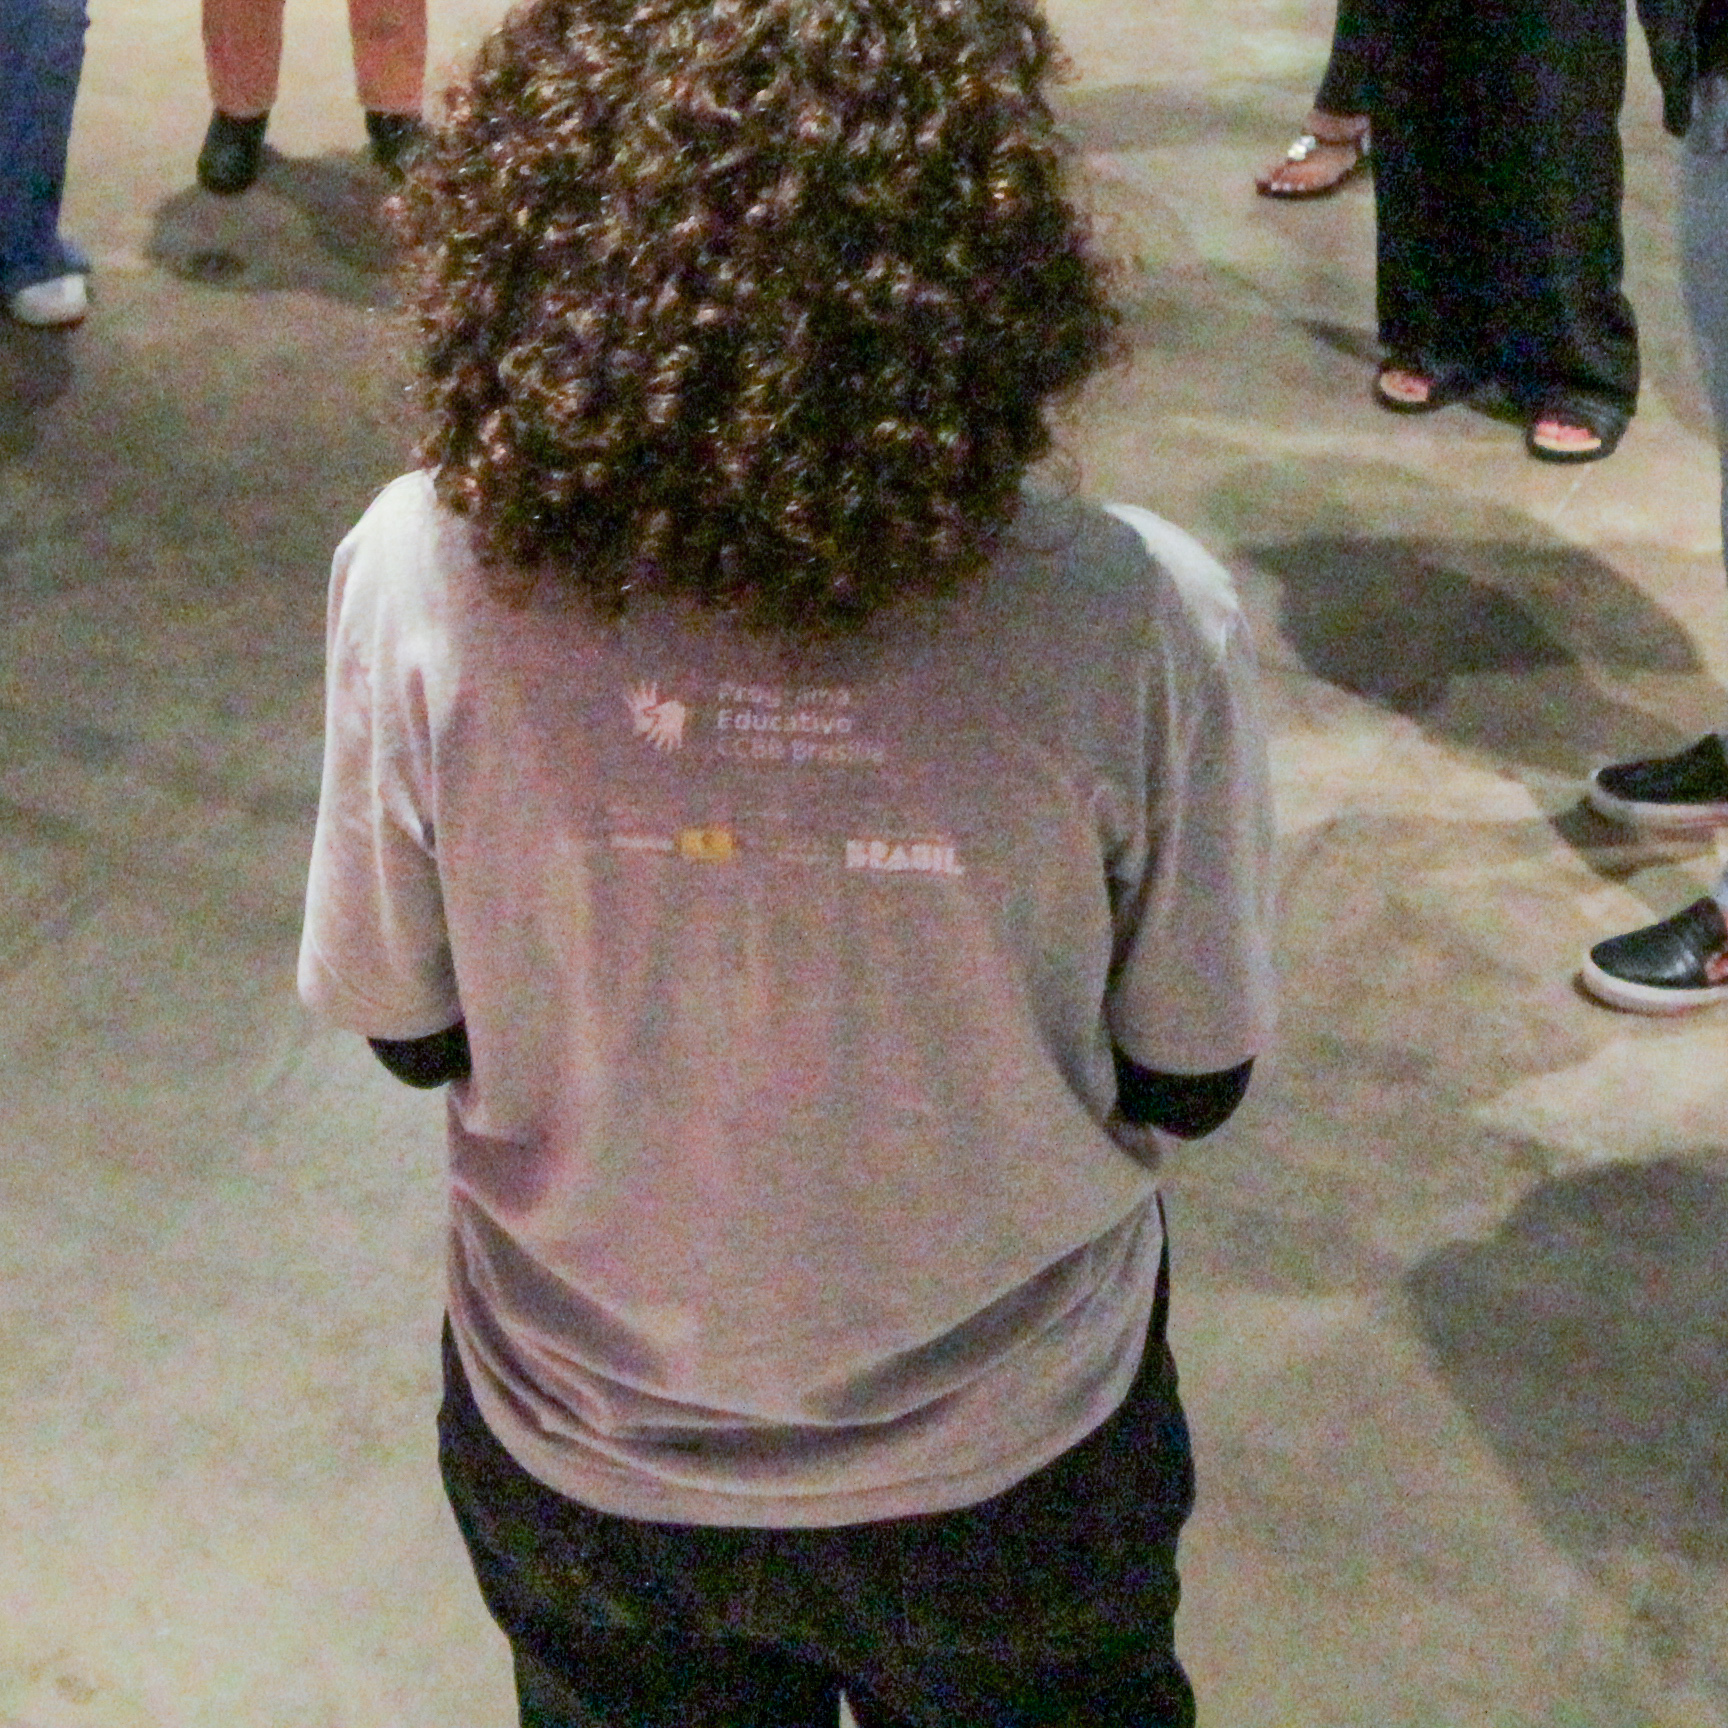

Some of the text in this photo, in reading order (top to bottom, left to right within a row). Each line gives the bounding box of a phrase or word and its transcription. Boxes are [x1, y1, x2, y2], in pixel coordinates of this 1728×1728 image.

[718, 681, 851, 709] Progma
[717, 708, 853, 734] Educativo
[845, 838, 966, 874] BRASIL
